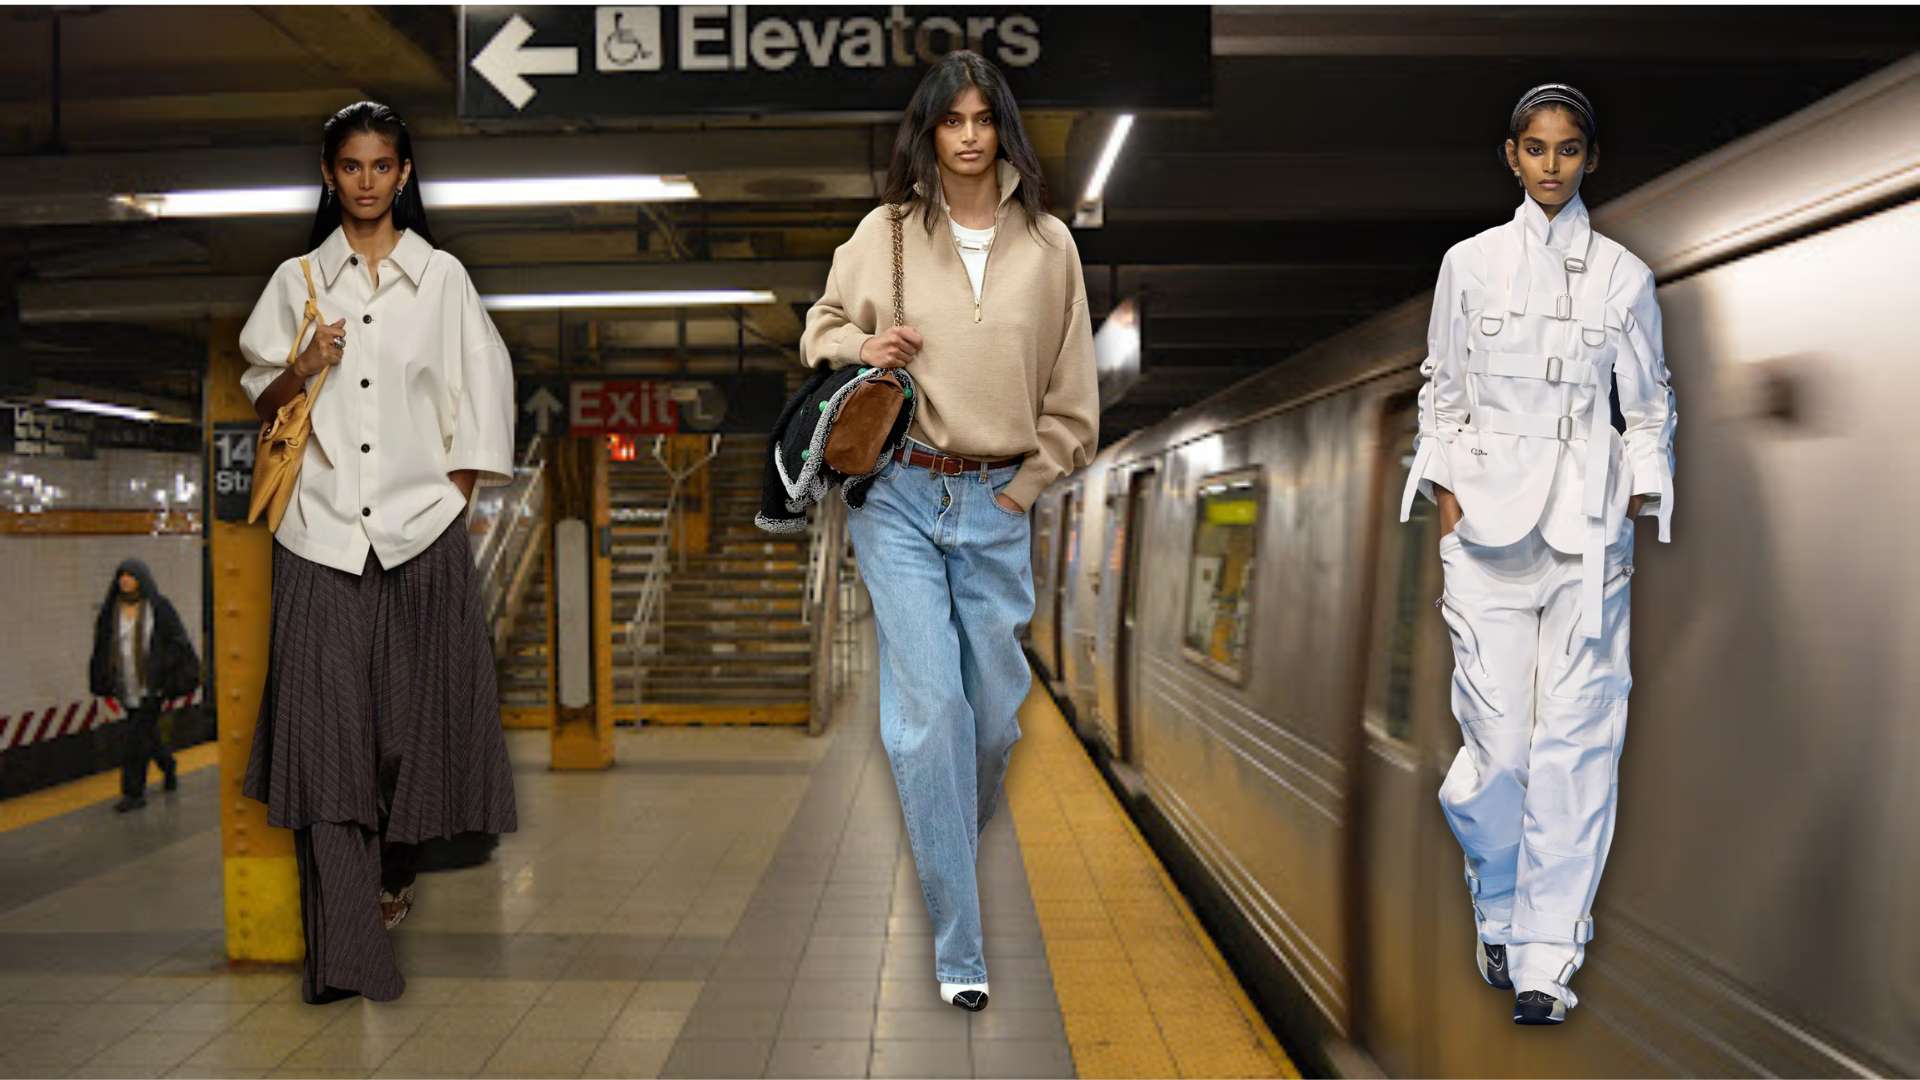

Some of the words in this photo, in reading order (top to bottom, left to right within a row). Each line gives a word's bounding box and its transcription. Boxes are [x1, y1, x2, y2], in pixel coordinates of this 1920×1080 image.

[679, 5, 1041, 71] Elevators
[569, 381, 674, 427] Exit
[214, 435, 255, 469] 14
